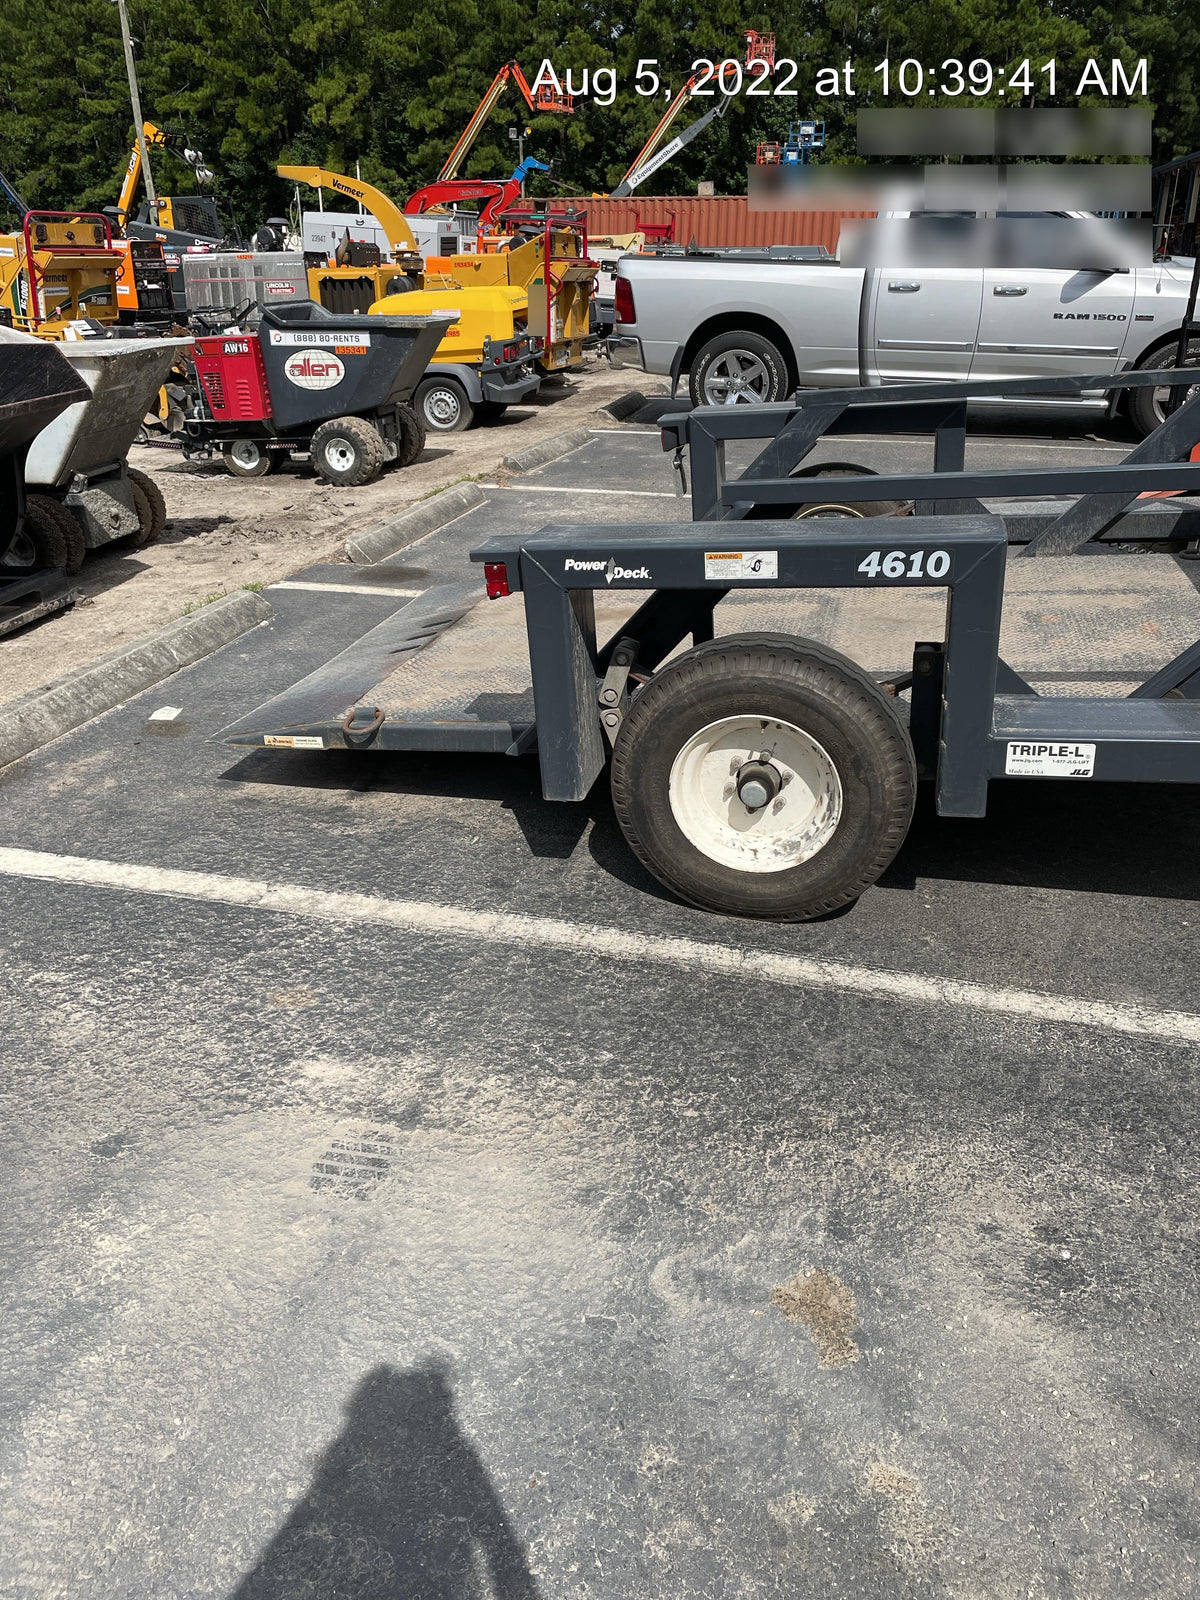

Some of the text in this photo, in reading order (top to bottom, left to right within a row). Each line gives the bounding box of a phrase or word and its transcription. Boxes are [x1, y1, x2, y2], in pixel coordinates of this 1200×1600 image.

[636, 143, 679, 180] EquipmentShare
[332, 178, 366, 199] Vermeer
[44, 274, 68, 283] ermeer
[1053, 312, 1091, 320] RAM
[293, 333, 360, 343] (888) 80-RENTS
[224, 342, 249, 353] AW16
[335, 345, 367, 354] 135341
[289, 357, 341, 377] allen
[713, 552, 739, 560] WARNING
[564, 558, 608, 571] Power
[857, 550, 951, 578] 4610
[1010, 745, 1084, 757] TRIPLE-L
[1070, 768, 1091, 776] JLG
